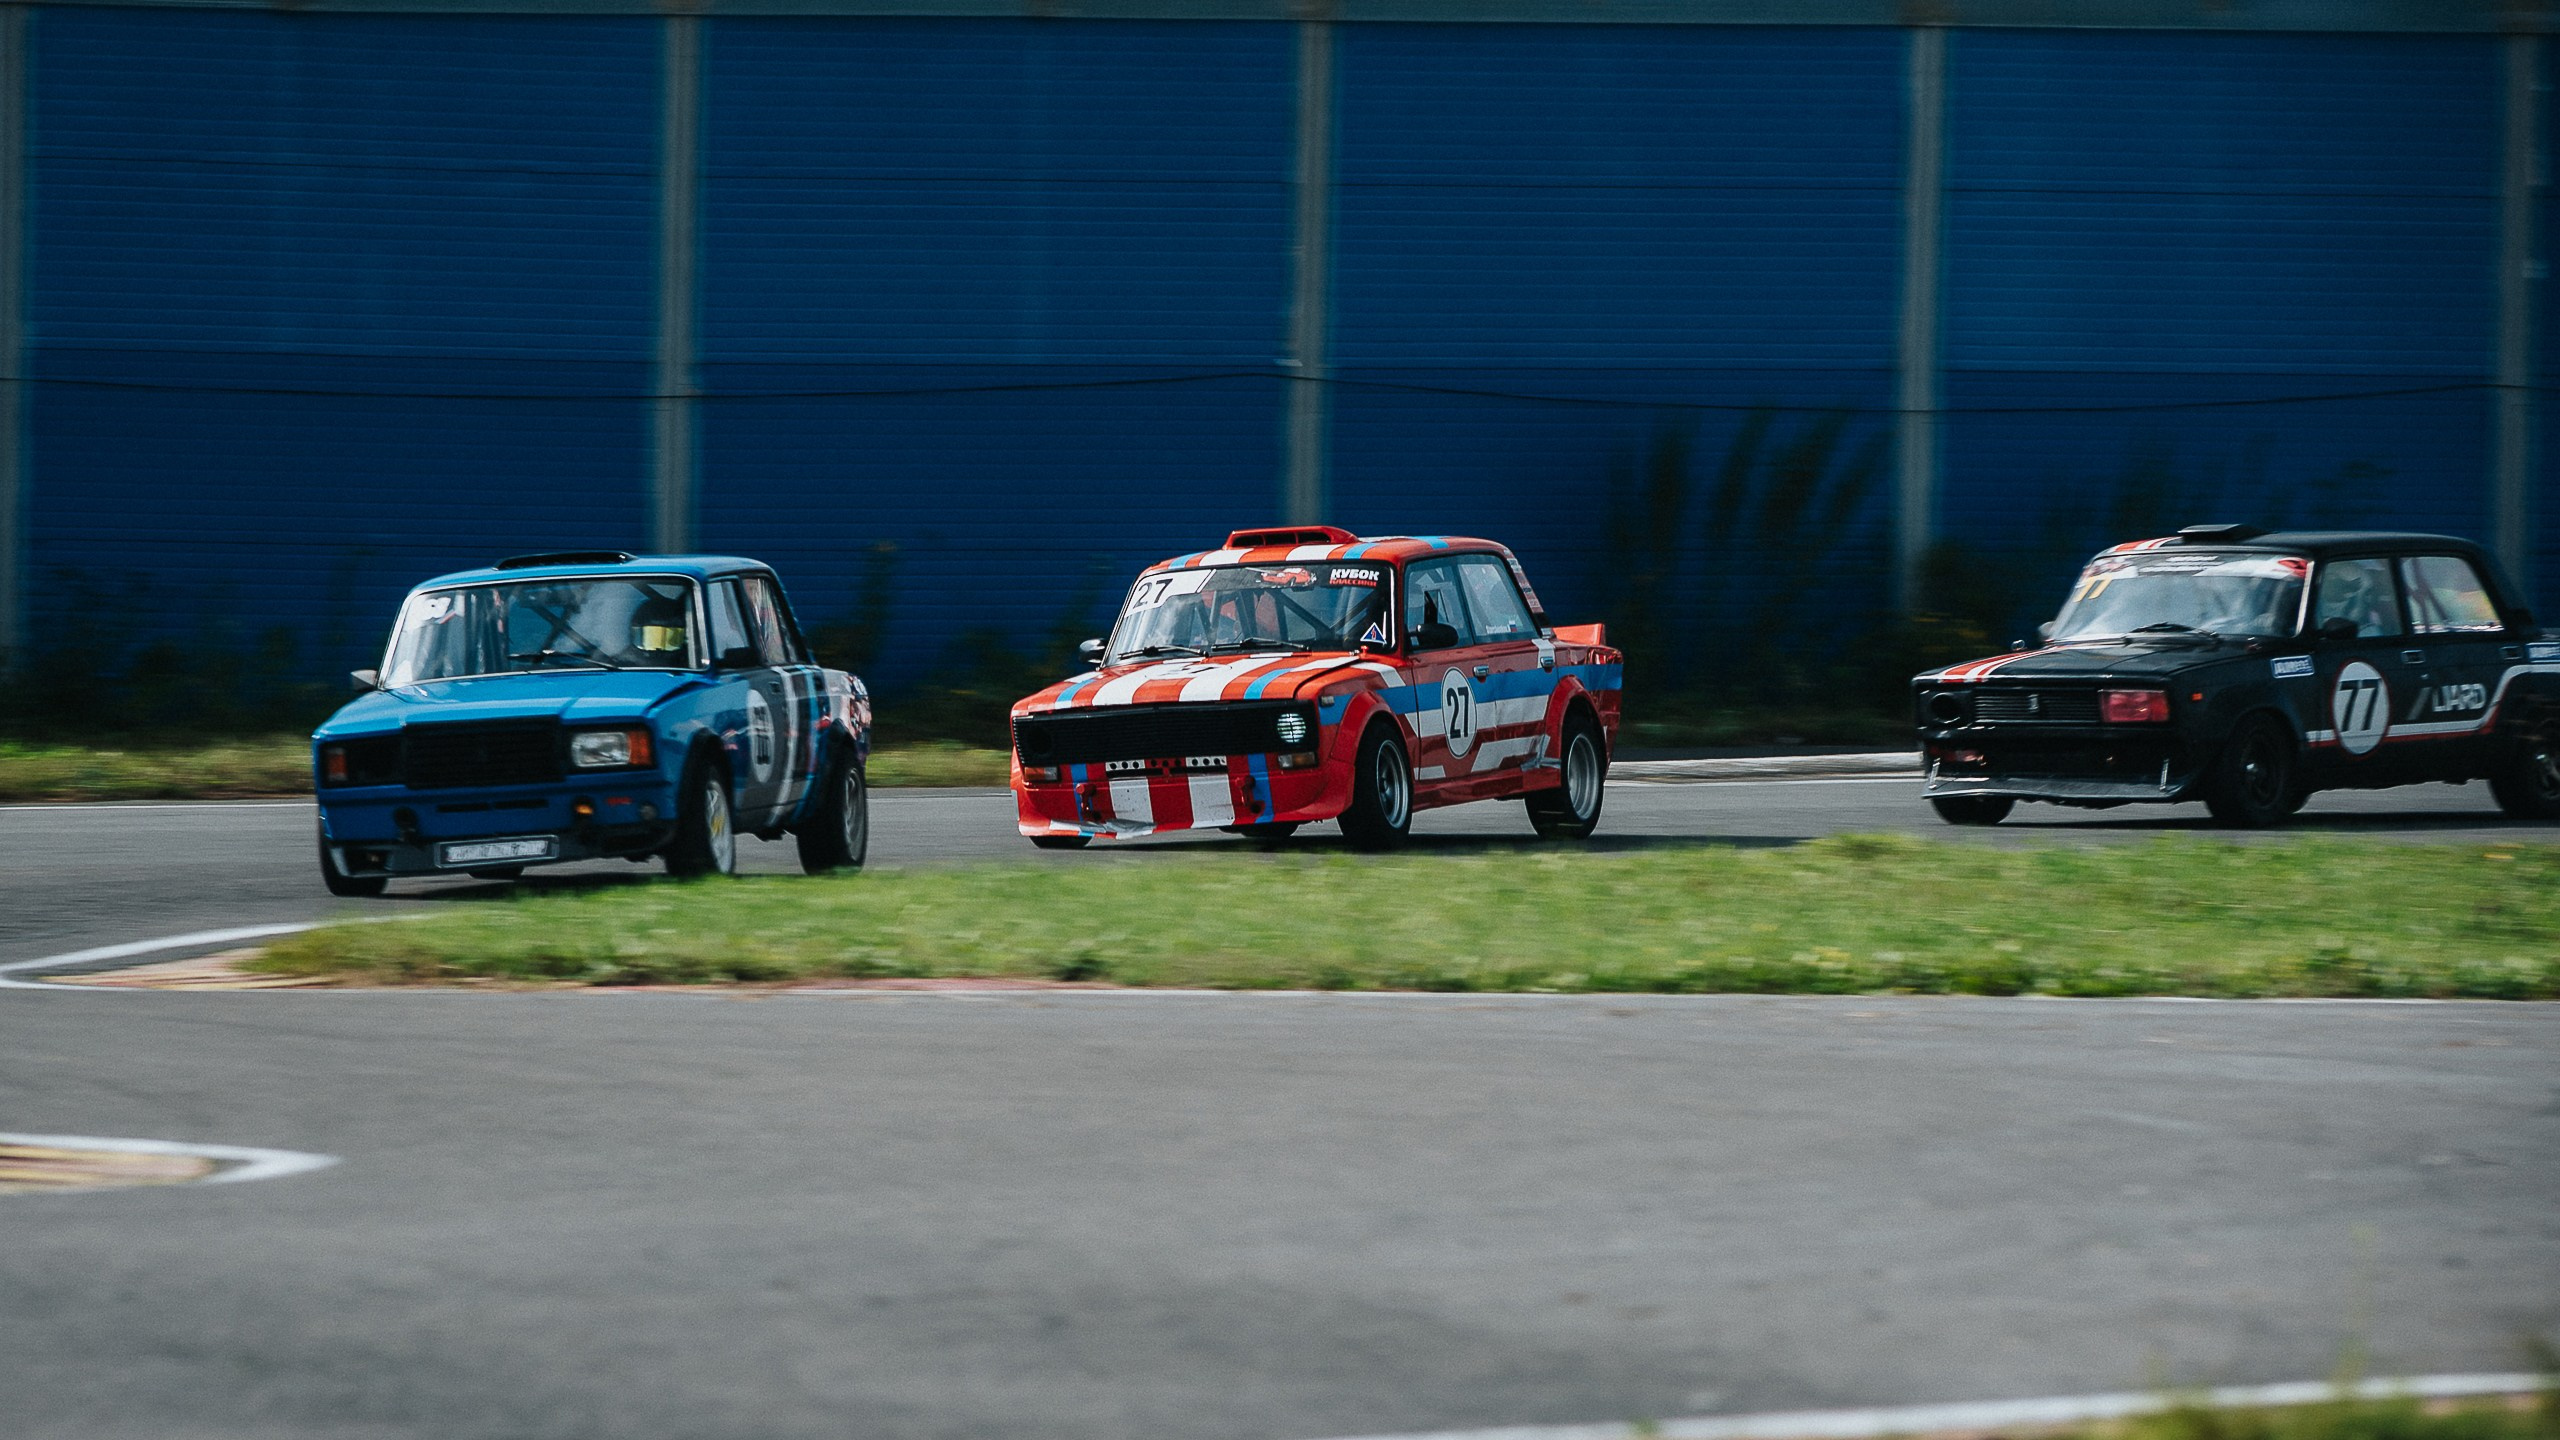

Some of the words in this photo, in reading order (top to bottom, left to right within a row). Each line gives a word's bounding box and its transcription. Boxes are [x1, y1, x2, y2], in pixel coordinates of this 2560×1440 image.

[1132, 578, 1173, 609] 27
[1330, 568, 1380, 581] КУБОК
[1446, 686, 1470, 739] 27
[2339, 678, 2382, 732] 77
